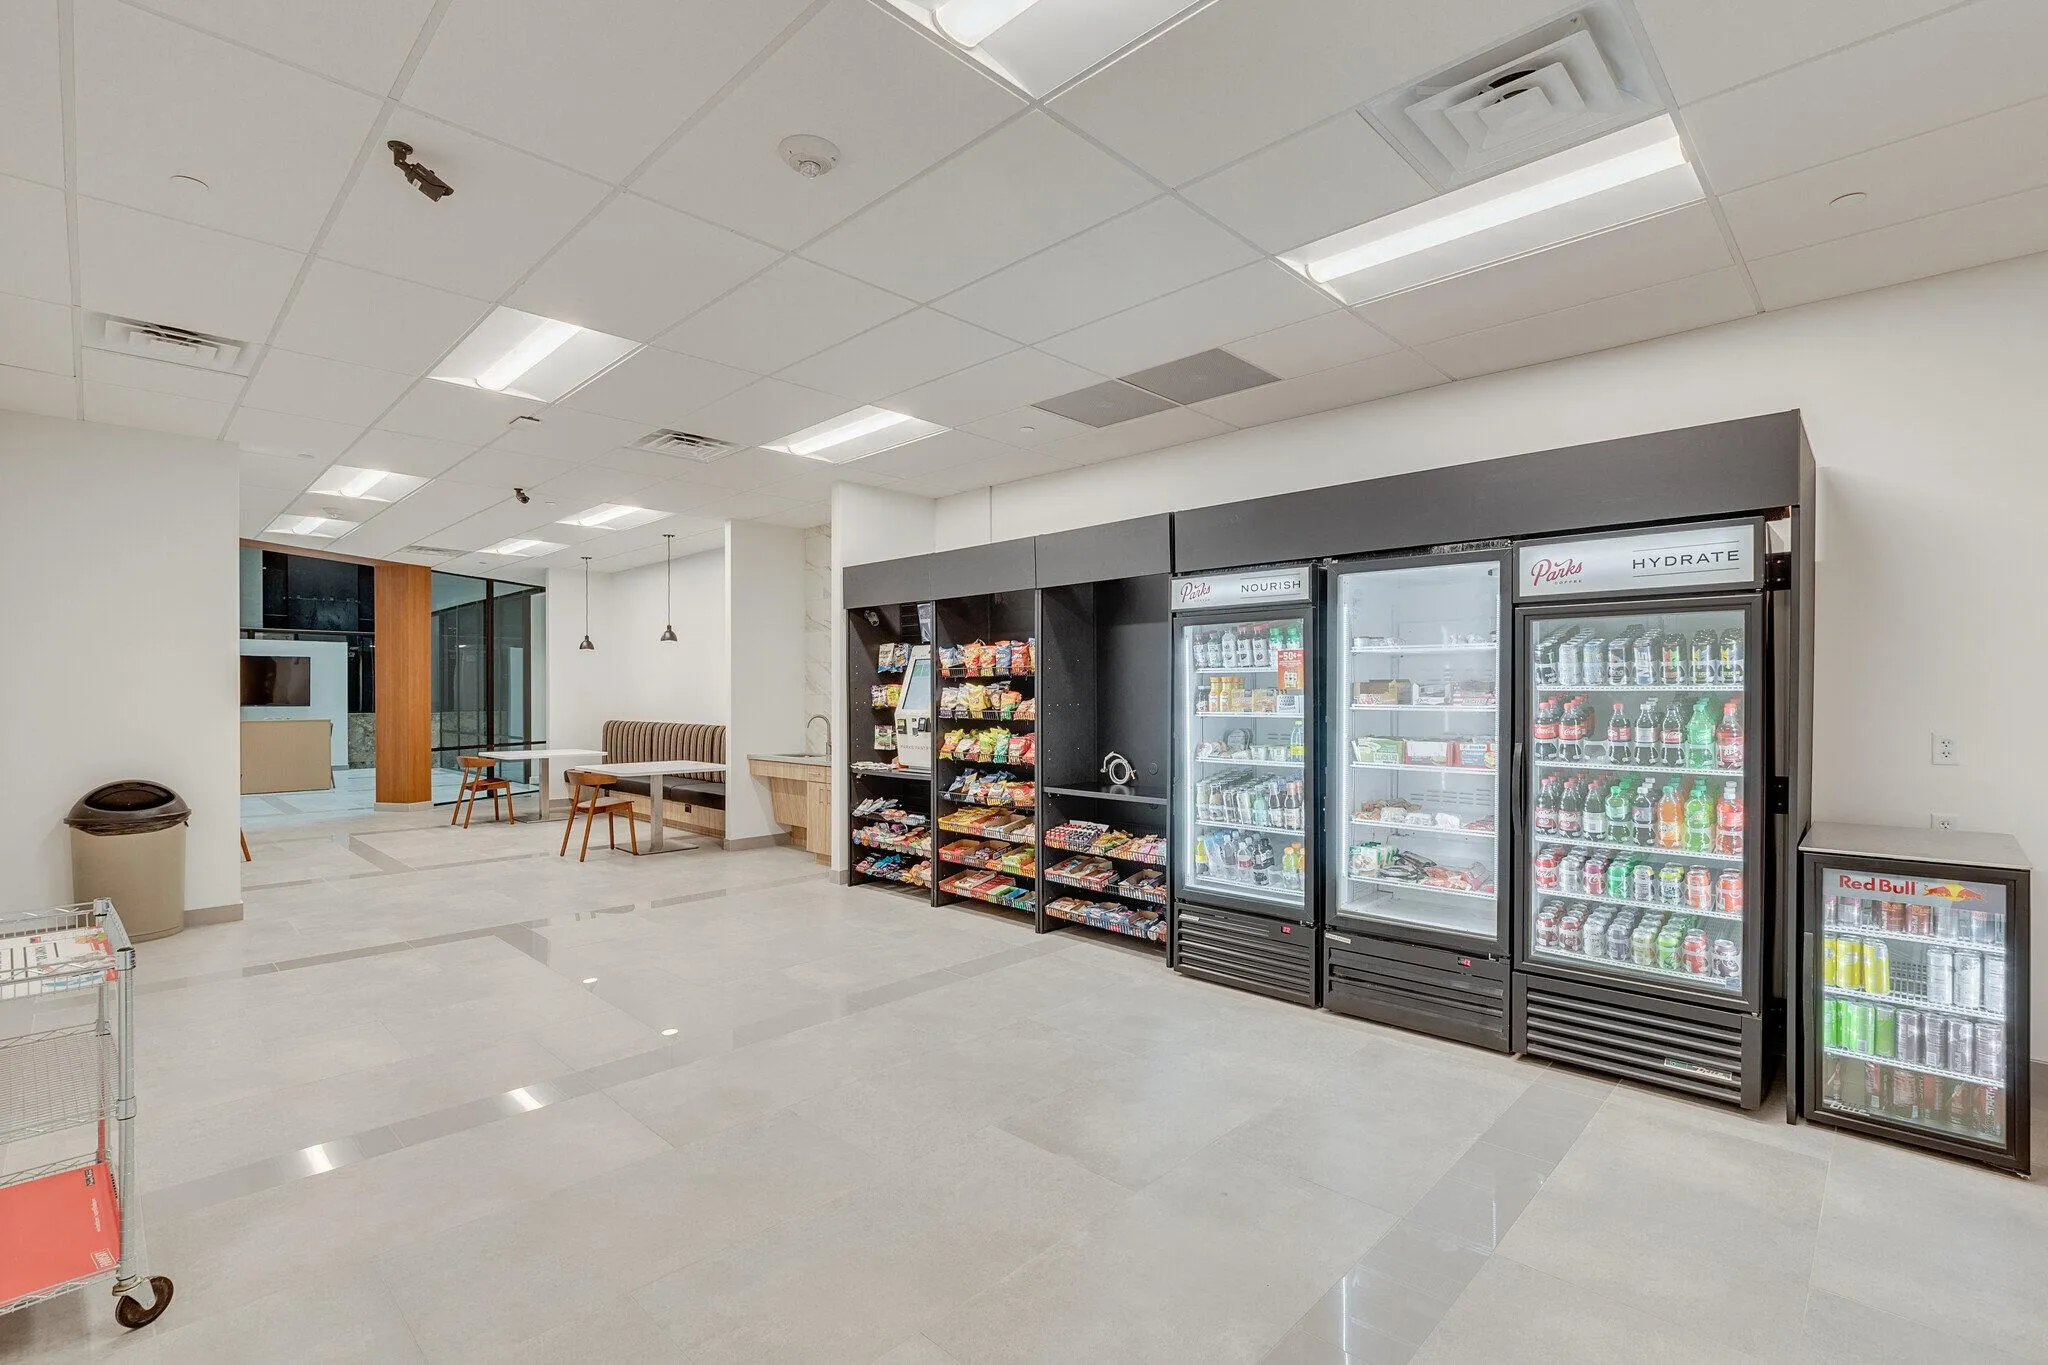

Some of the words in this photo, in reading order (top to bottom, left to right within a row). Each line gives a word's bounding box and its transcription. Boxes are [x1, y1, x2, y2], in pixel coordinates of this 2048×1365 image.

[1632, 549, 1740, 570] HYDRATE
[1531, 558, 1583, 587] Parks
[1180, 581, 1211, 603] Parks
[1241, 580, 1301, 593] NOURISH
[1839, 874, 1876, 892] Red
[1878, 878, 1917, 896] Bull
